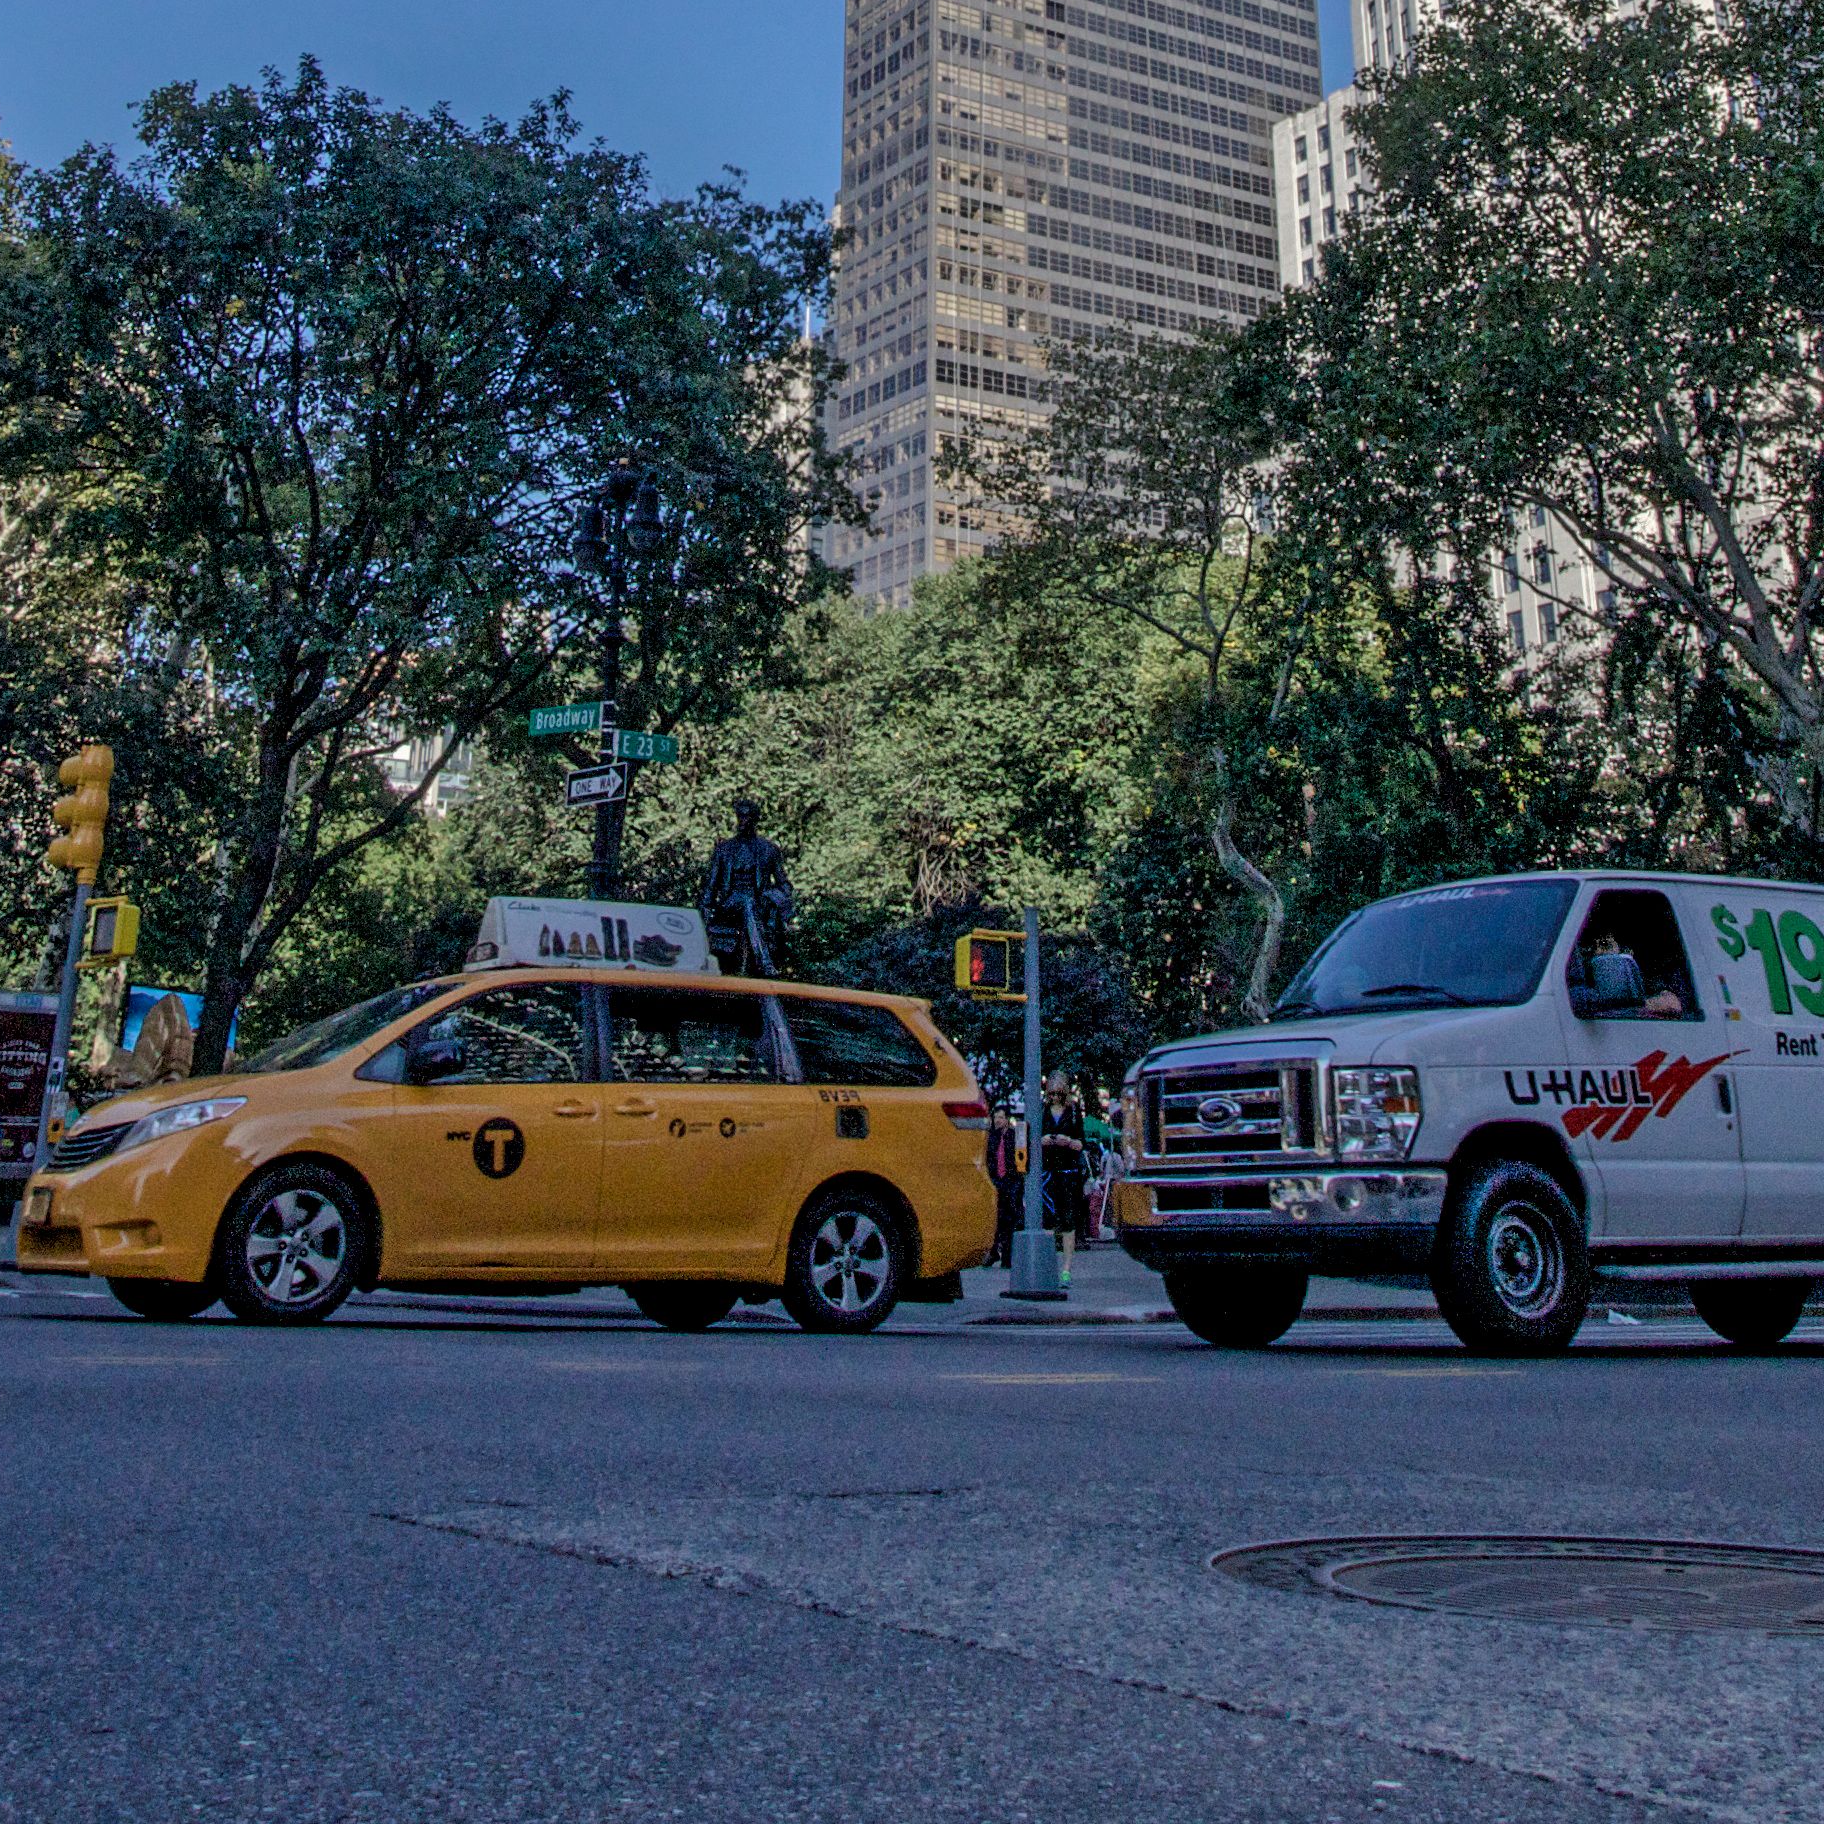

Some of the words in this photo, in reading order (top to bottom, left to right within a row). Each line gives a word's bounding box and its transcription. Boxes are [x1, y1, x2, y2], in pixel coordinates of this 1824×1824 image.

[535, 709, 595, 730] Broadway
[623, 736, 630, 754] E
[637, 736, 653, 756] 23
[575, 780, 593, 795] ONE
[600, 776, 616, 790] WAY
[1776, 1032, 1817, 1056] Rent
[447, 1131, 471, 1142] NYC
